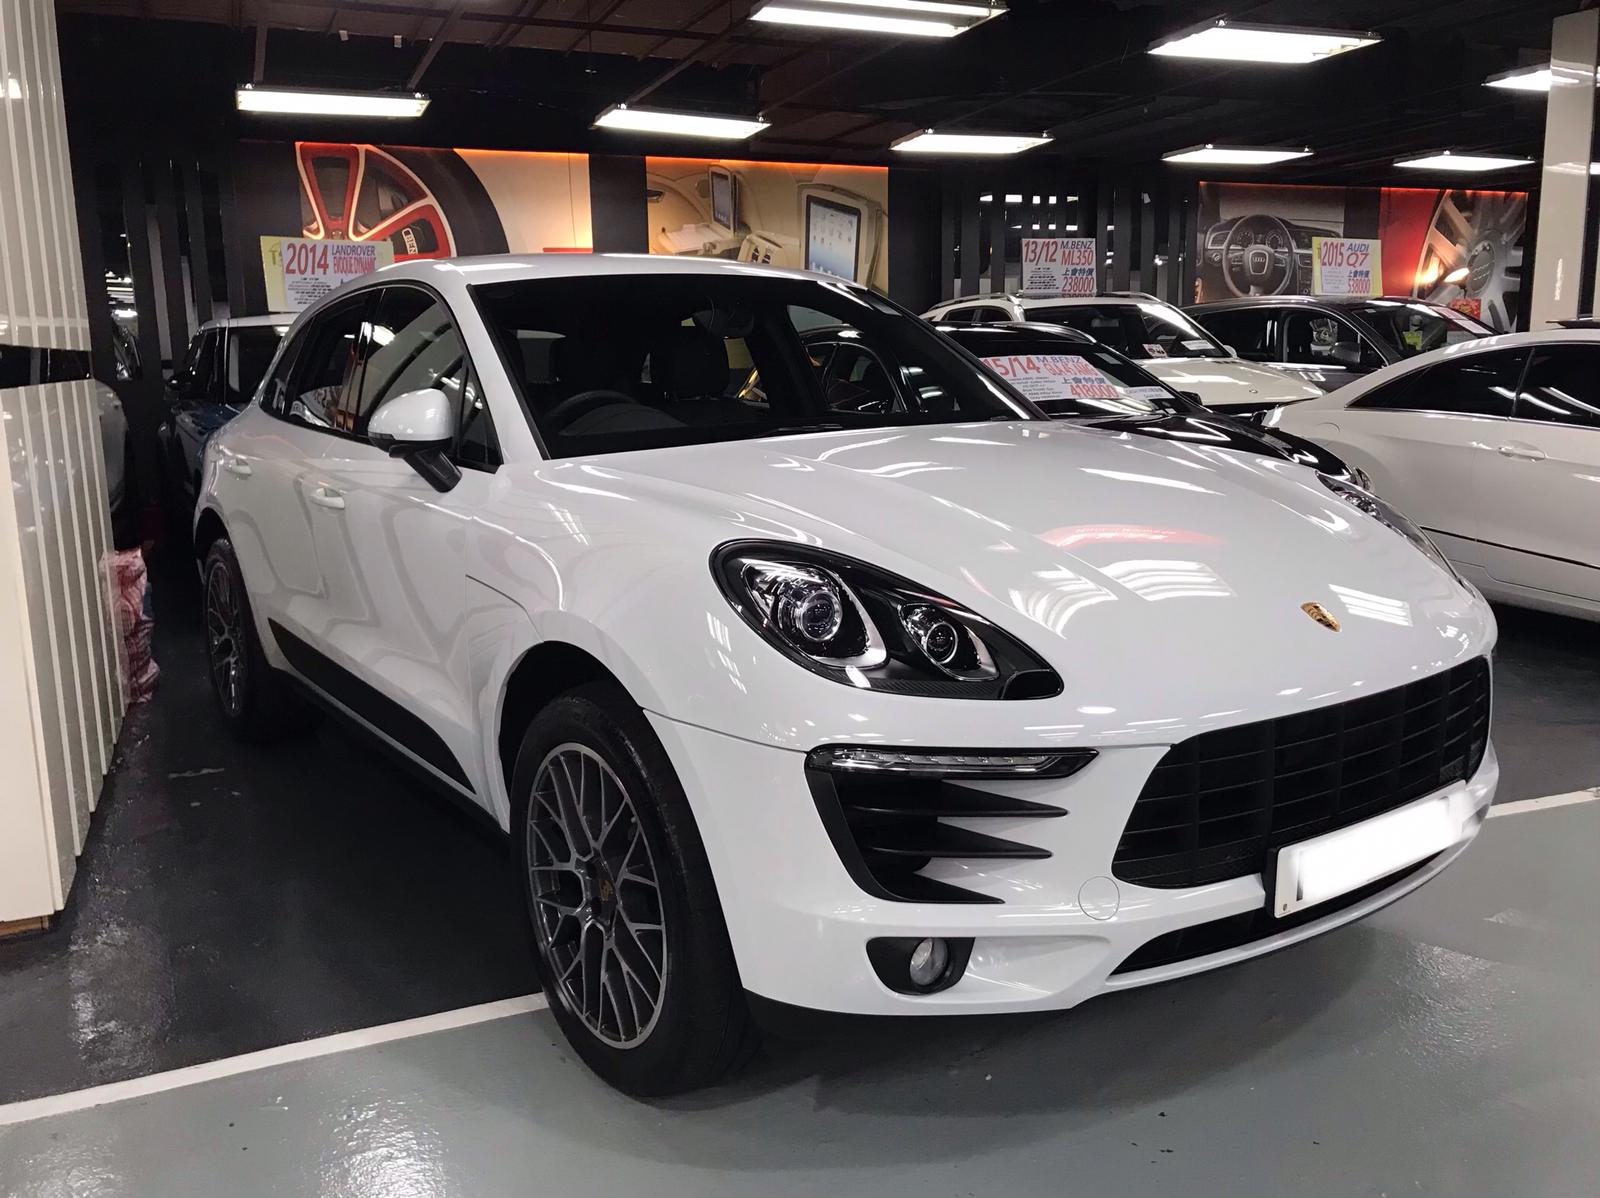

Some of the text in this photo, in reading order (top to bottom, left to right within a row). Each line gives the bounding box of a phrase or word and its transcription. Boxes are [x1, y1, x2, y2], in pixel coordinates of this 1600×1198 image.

[332, 244, 376, 256] LANDROVER
[1024, 240, 1058, 265] 13/12
[1060, 241, 1093, 249] M.BENZ
[1347, 243, 1369, 252] AUDI
[285, 243, 329, 275] 2014
[1061, 250, 1093, 265] ML350
[1321, 242, 1344, 266] 2015
[1346, 252, 1369, 267] Q7
[1061, 277, 1094, 292] 238000
[1070, 384, 1120, 397] 418000
